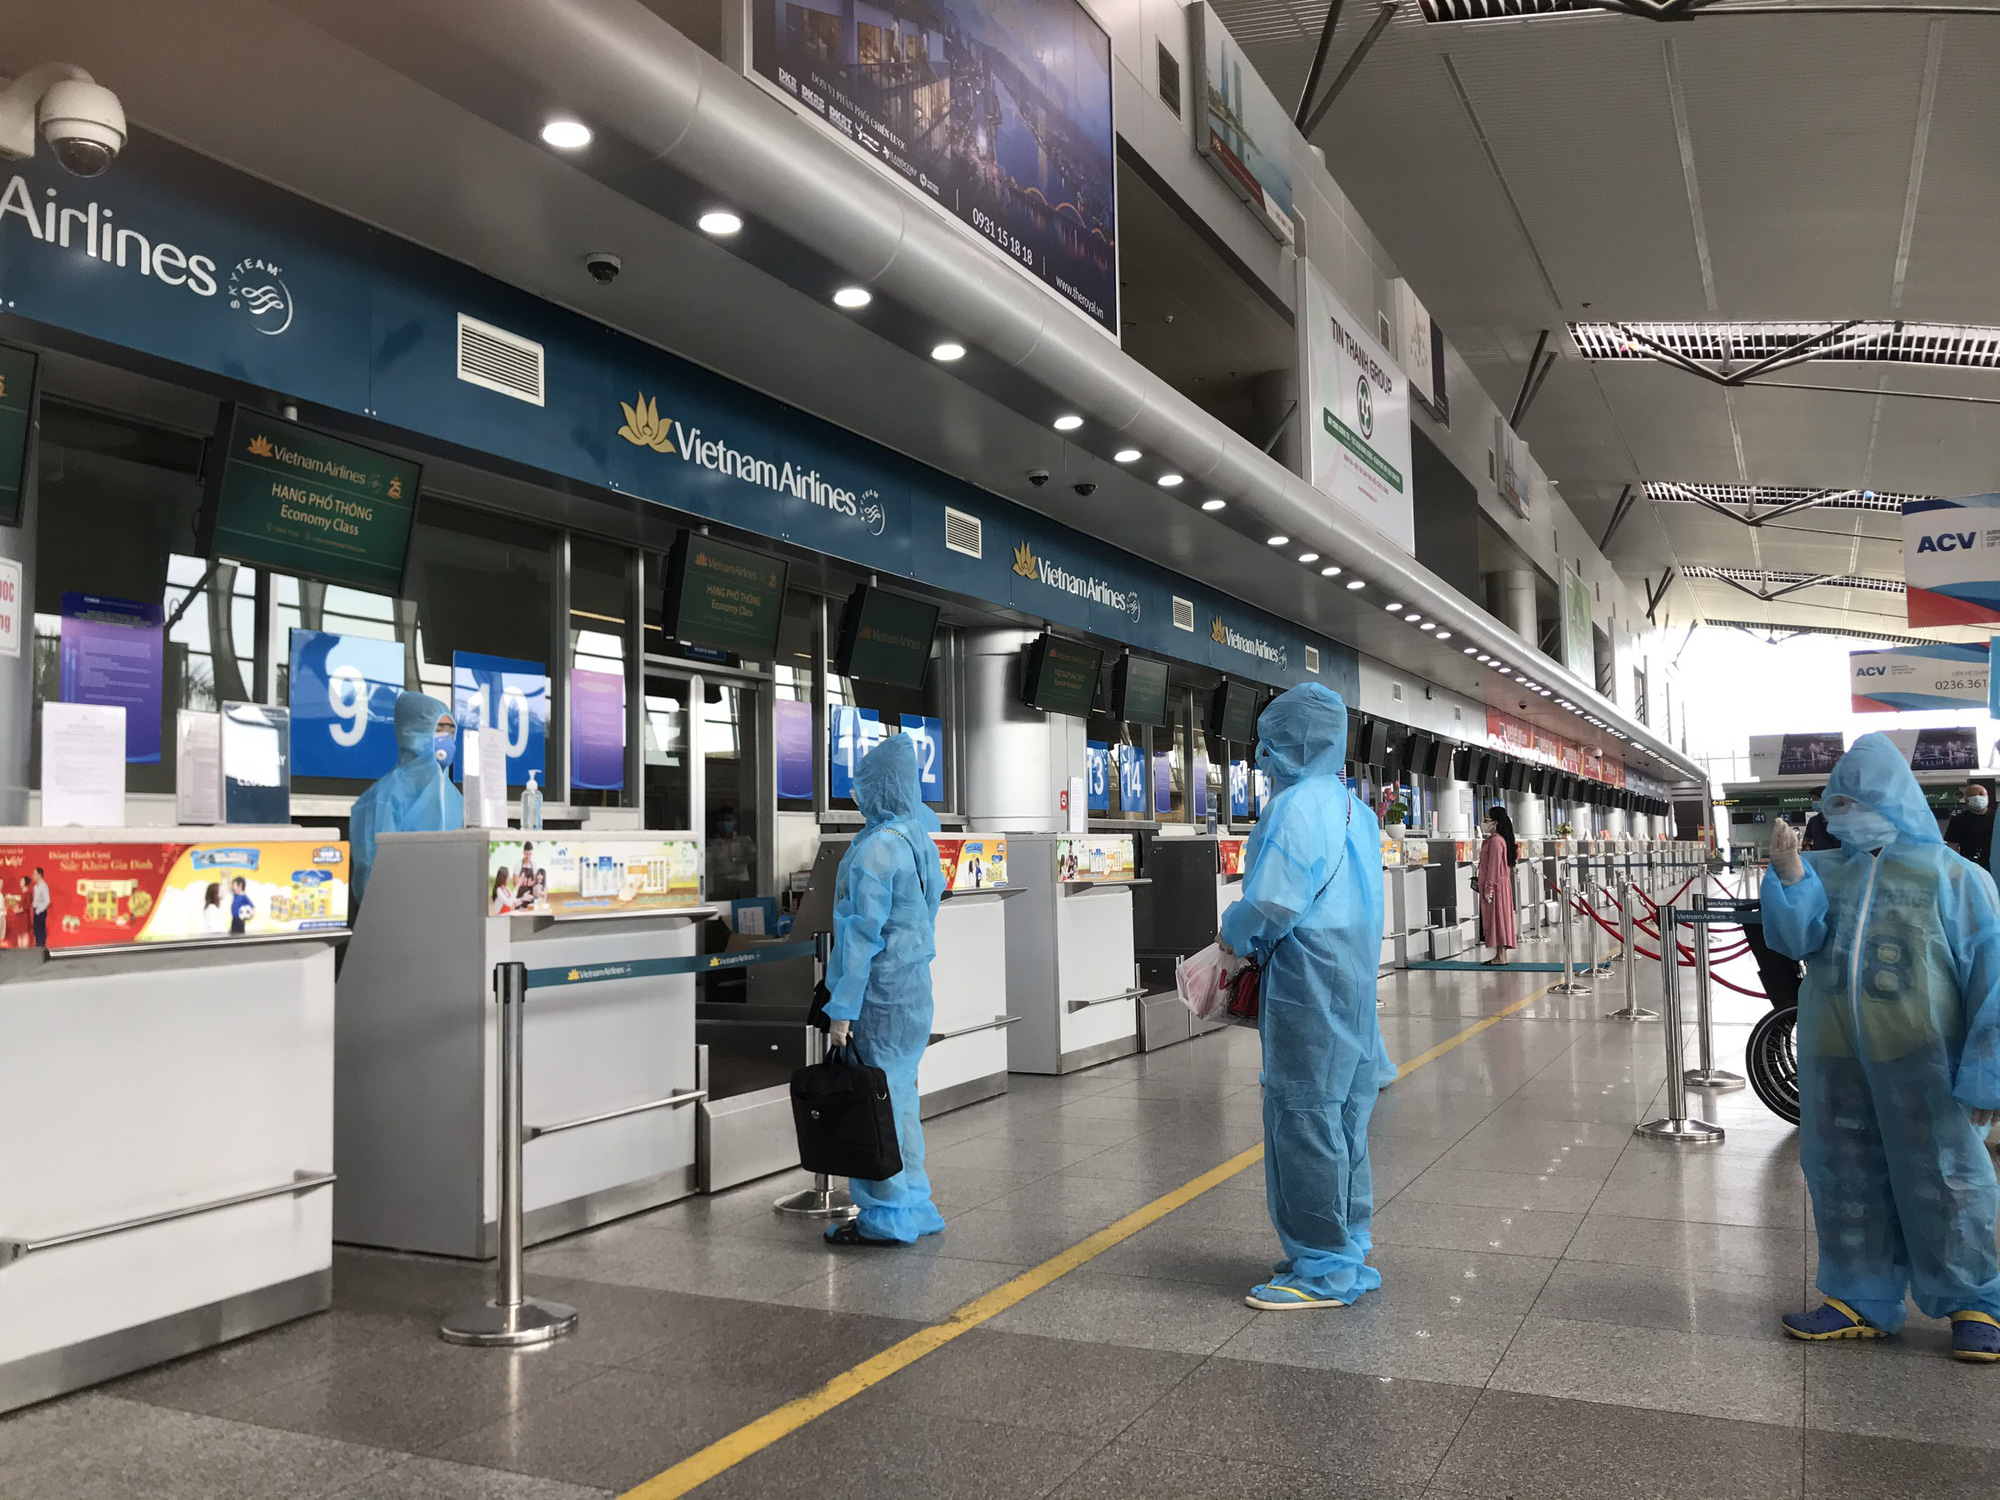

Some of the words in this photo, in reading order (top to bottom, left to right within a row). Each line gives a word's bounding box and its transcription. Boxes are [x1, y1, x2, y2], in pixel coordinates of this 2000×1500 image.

[972, 207, 995, 238] 0931
[997, 226, 1008, 247] 15
[1010, 236, 1021, 257] 18
[1022, 245, 1033, 266] 18
[1055, 275, 1104, 320] www.theroyal.vn
[1331, 316, 1344, 349] TIN
[1344, 331, 1369, 375] THANH
[1369, 359, 1393, 397] GROUP
[272, 482, 307, 506] HẠNG
[335, 499, 373, 521] THÔNG
[280, 504, 331, 531] Economy
[333, 518, 359, 536] Class
[1916, 531, 1977, 553] ACV
[1856, 666, 1886, 677] ACV
[1935, 678, 1987, 690] 0236.361
[328, 664, 369, 747] 9
[466, 682, 530, 758] 10
[1087, 755, 1104, 796] 13
[1124, 761, 1142, 798] 14
[1232, 774, 1245, 804] 15
[1754, 813, 1766, 822] 41
